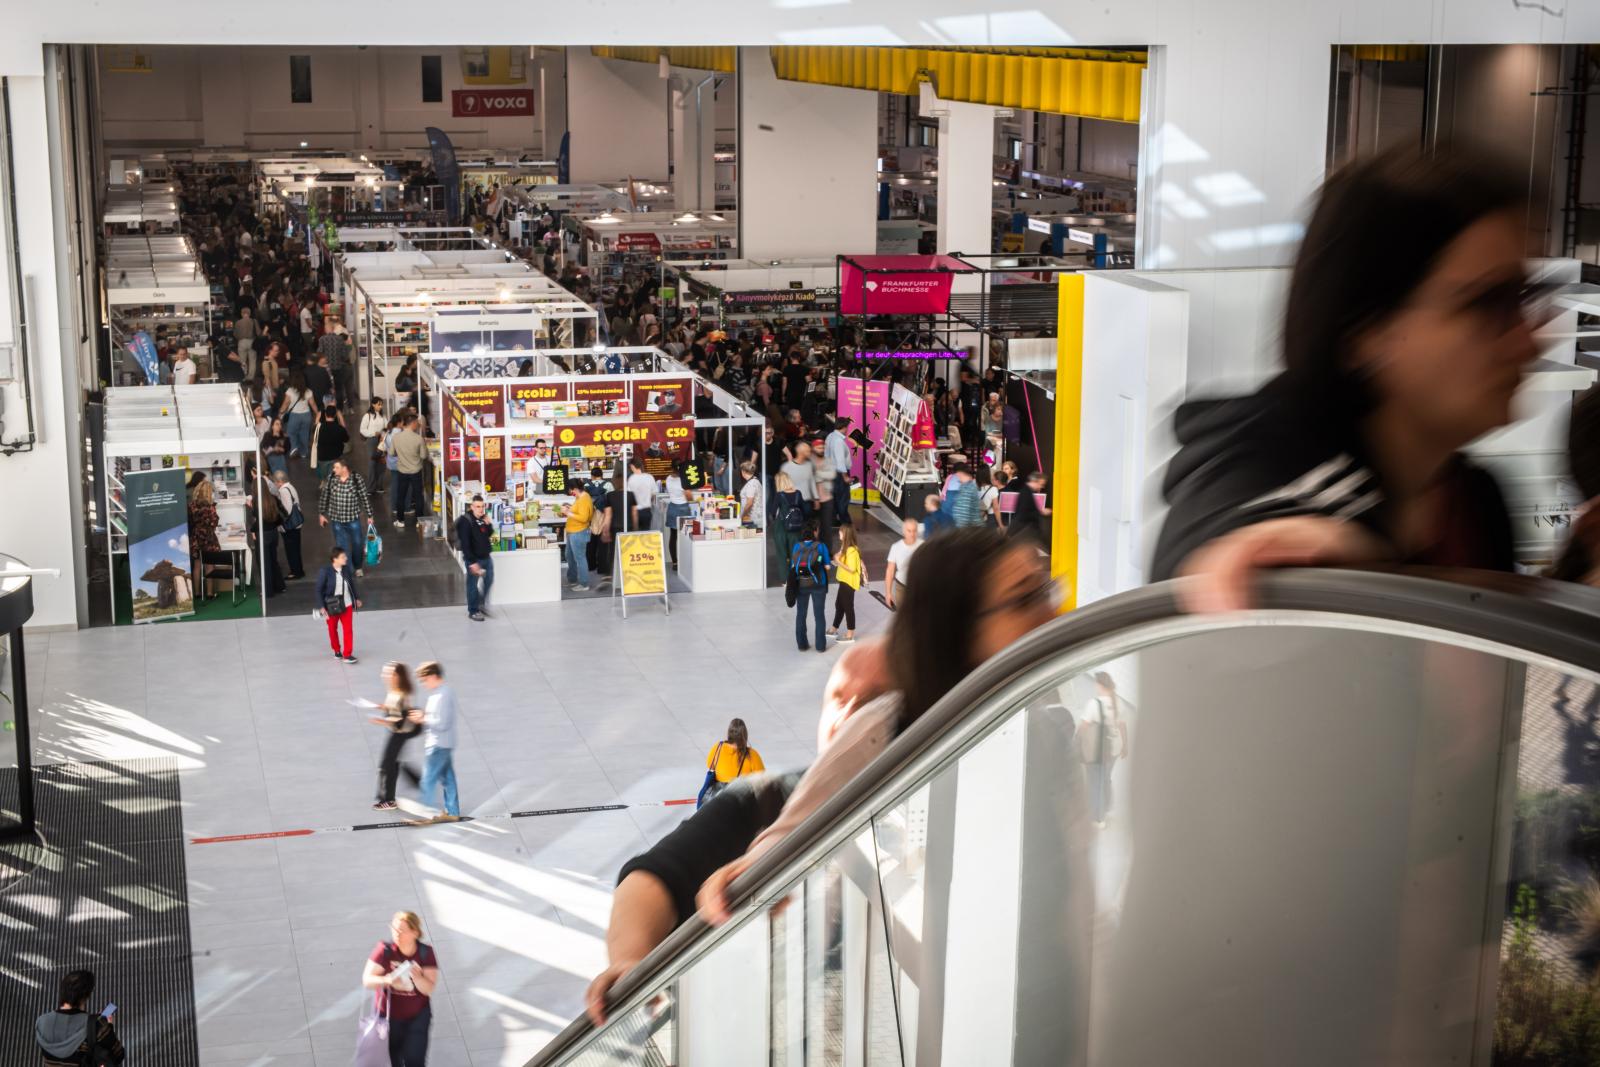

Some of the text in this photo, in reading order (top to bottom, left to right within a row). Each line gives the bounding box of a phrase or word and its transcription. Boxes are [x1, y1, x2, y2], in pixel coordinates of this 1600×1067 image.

[482, 97, 527, 109] voxa
[795, 292, 816, 301] Kiadó
[516, 388, 558, 399] scolar
[592, 426, 689, 442] scolar C30
[629, 553, 655, 562] 25%
